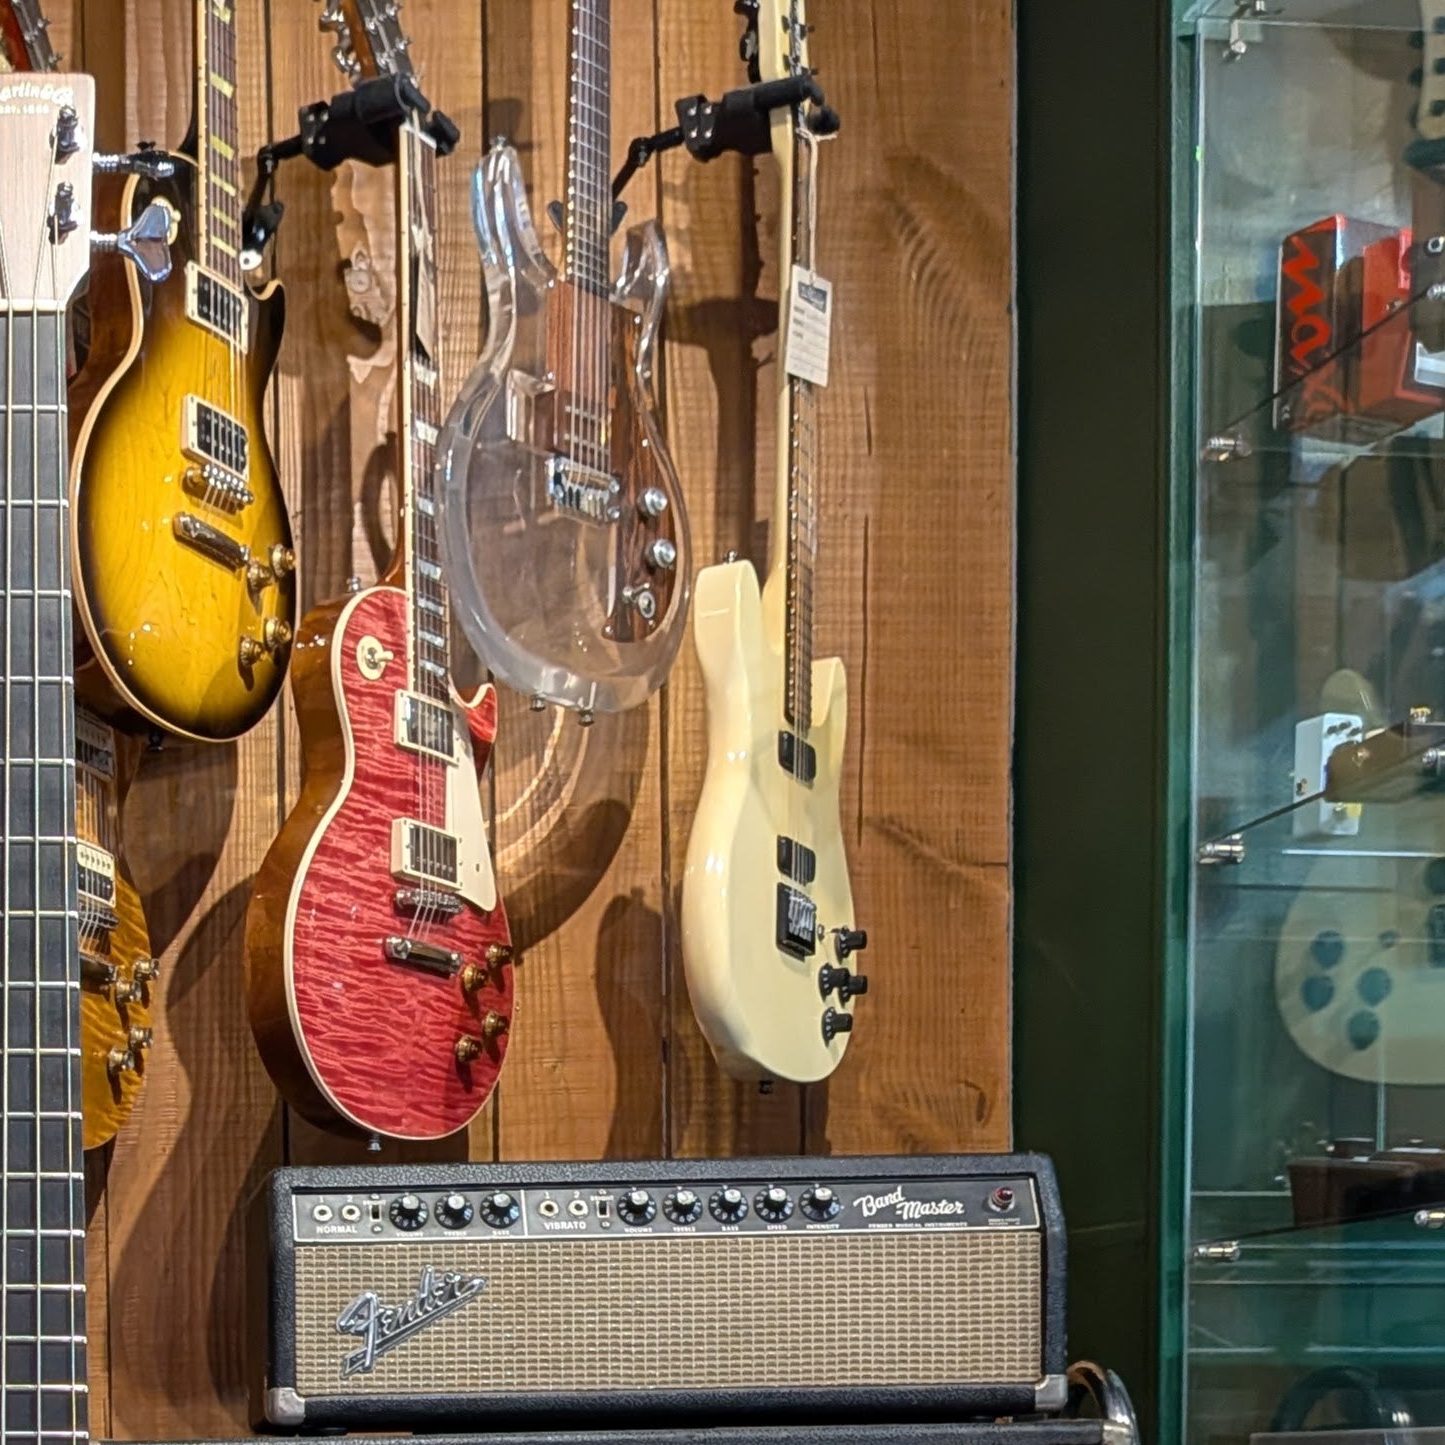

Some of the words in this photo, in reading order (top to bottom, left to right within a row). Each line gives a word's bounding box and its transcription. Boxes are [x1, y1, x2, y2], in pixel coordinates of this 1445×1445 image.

[853, 1185, 906, 1218] Band
[895, 1201, 965, 1220] Master
[316, 1225, 358, 1234] NORMAL
[543, 1221, 587, 1231] VIBRATO
[336, 1264, 487, 1378] Fender
